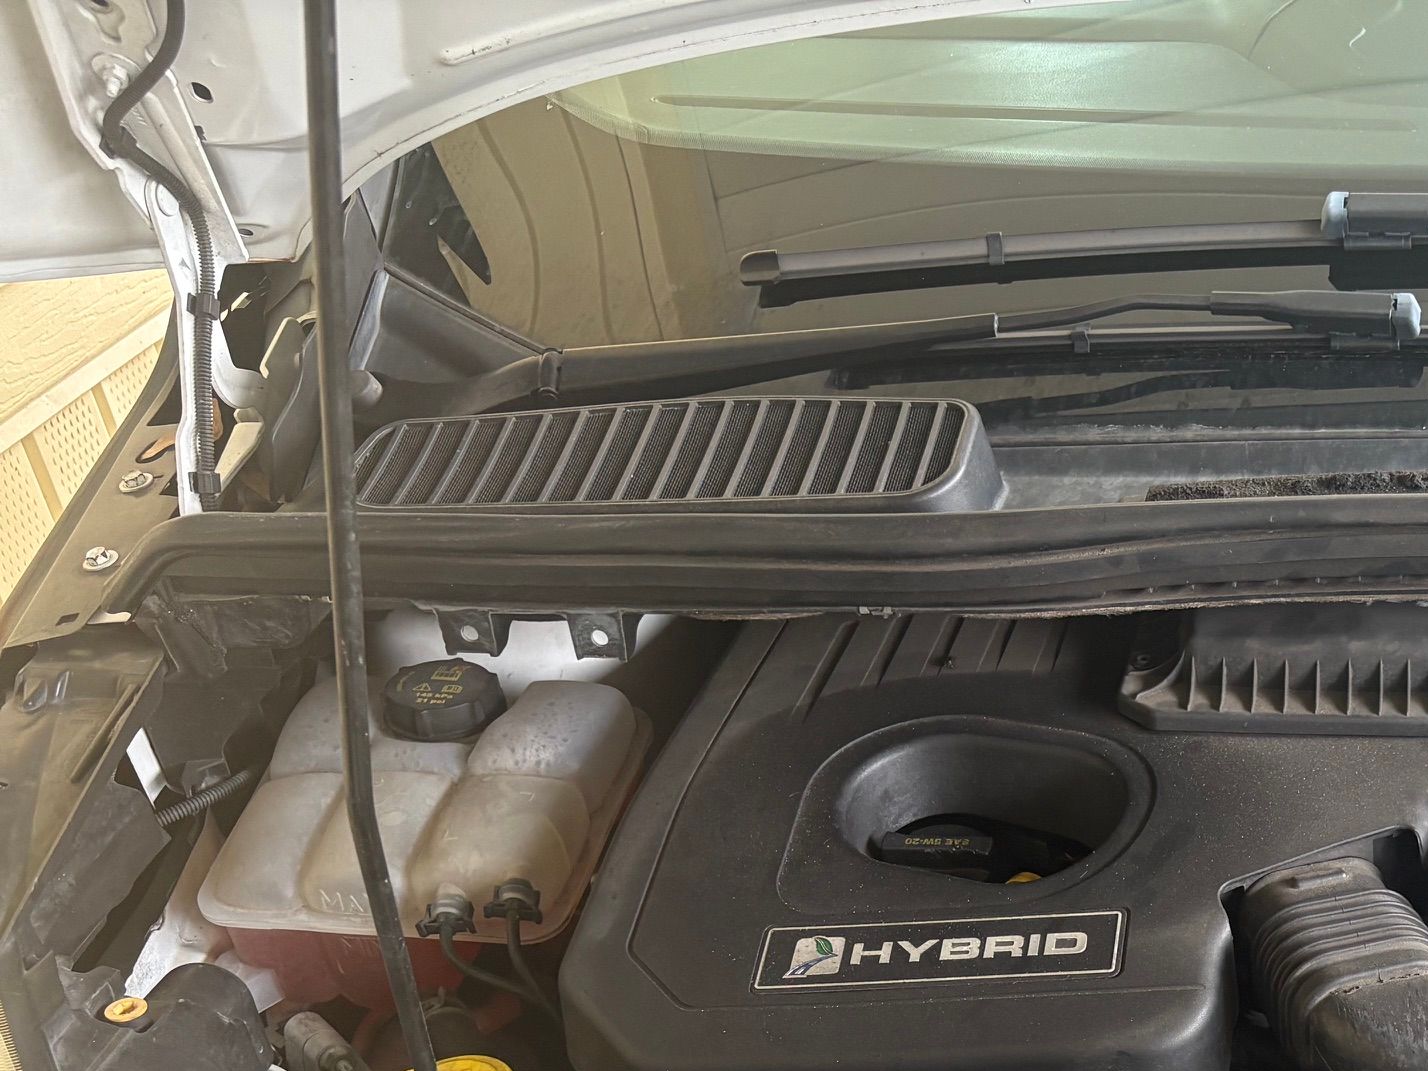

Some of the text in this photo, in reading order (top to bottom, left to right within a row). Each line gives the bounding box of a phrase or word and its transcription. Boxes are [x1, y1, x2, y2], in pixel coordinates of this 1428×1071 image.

[944, 838, 970, 846] SAE
[319, 888, 370, 913] MA
[850, 931, 1089, 966] HYBRID
